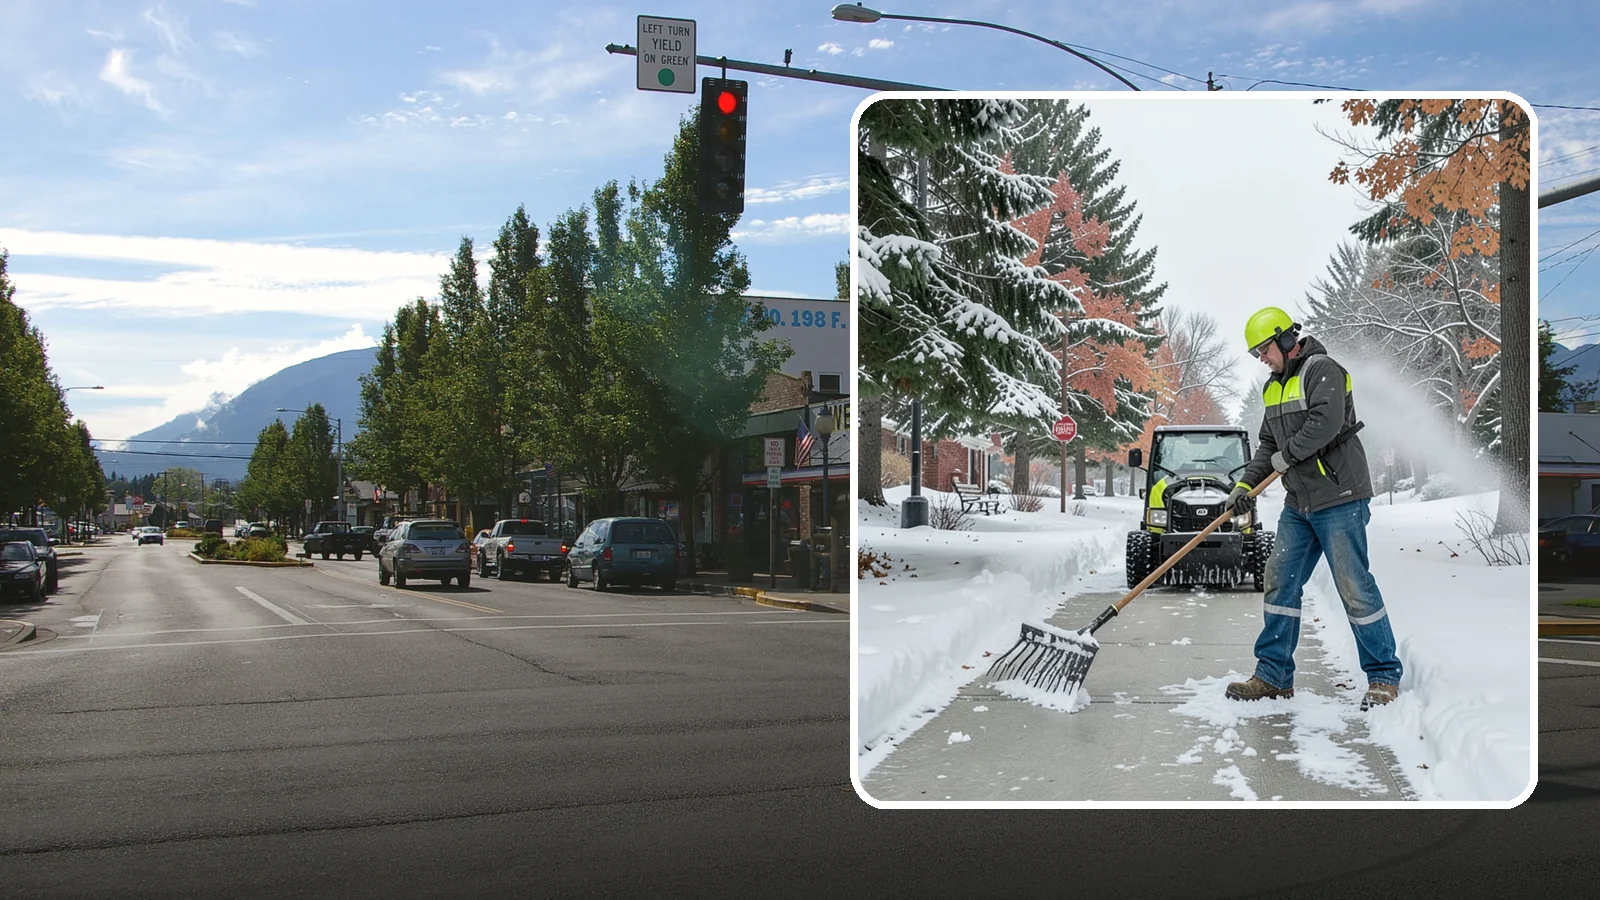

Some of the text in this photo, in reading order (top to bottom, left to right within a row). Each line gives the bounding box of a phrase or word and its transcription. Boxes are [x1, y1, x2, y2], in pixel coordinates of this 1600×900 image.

[643, 24, 690, 36] LEFT TURN
[652, 38, 682, 51] YIELD
[644, 53, 689, 66] ON GREEN
[791, 309, 826, 328] 198
[831, 311, 846, 329] F.
